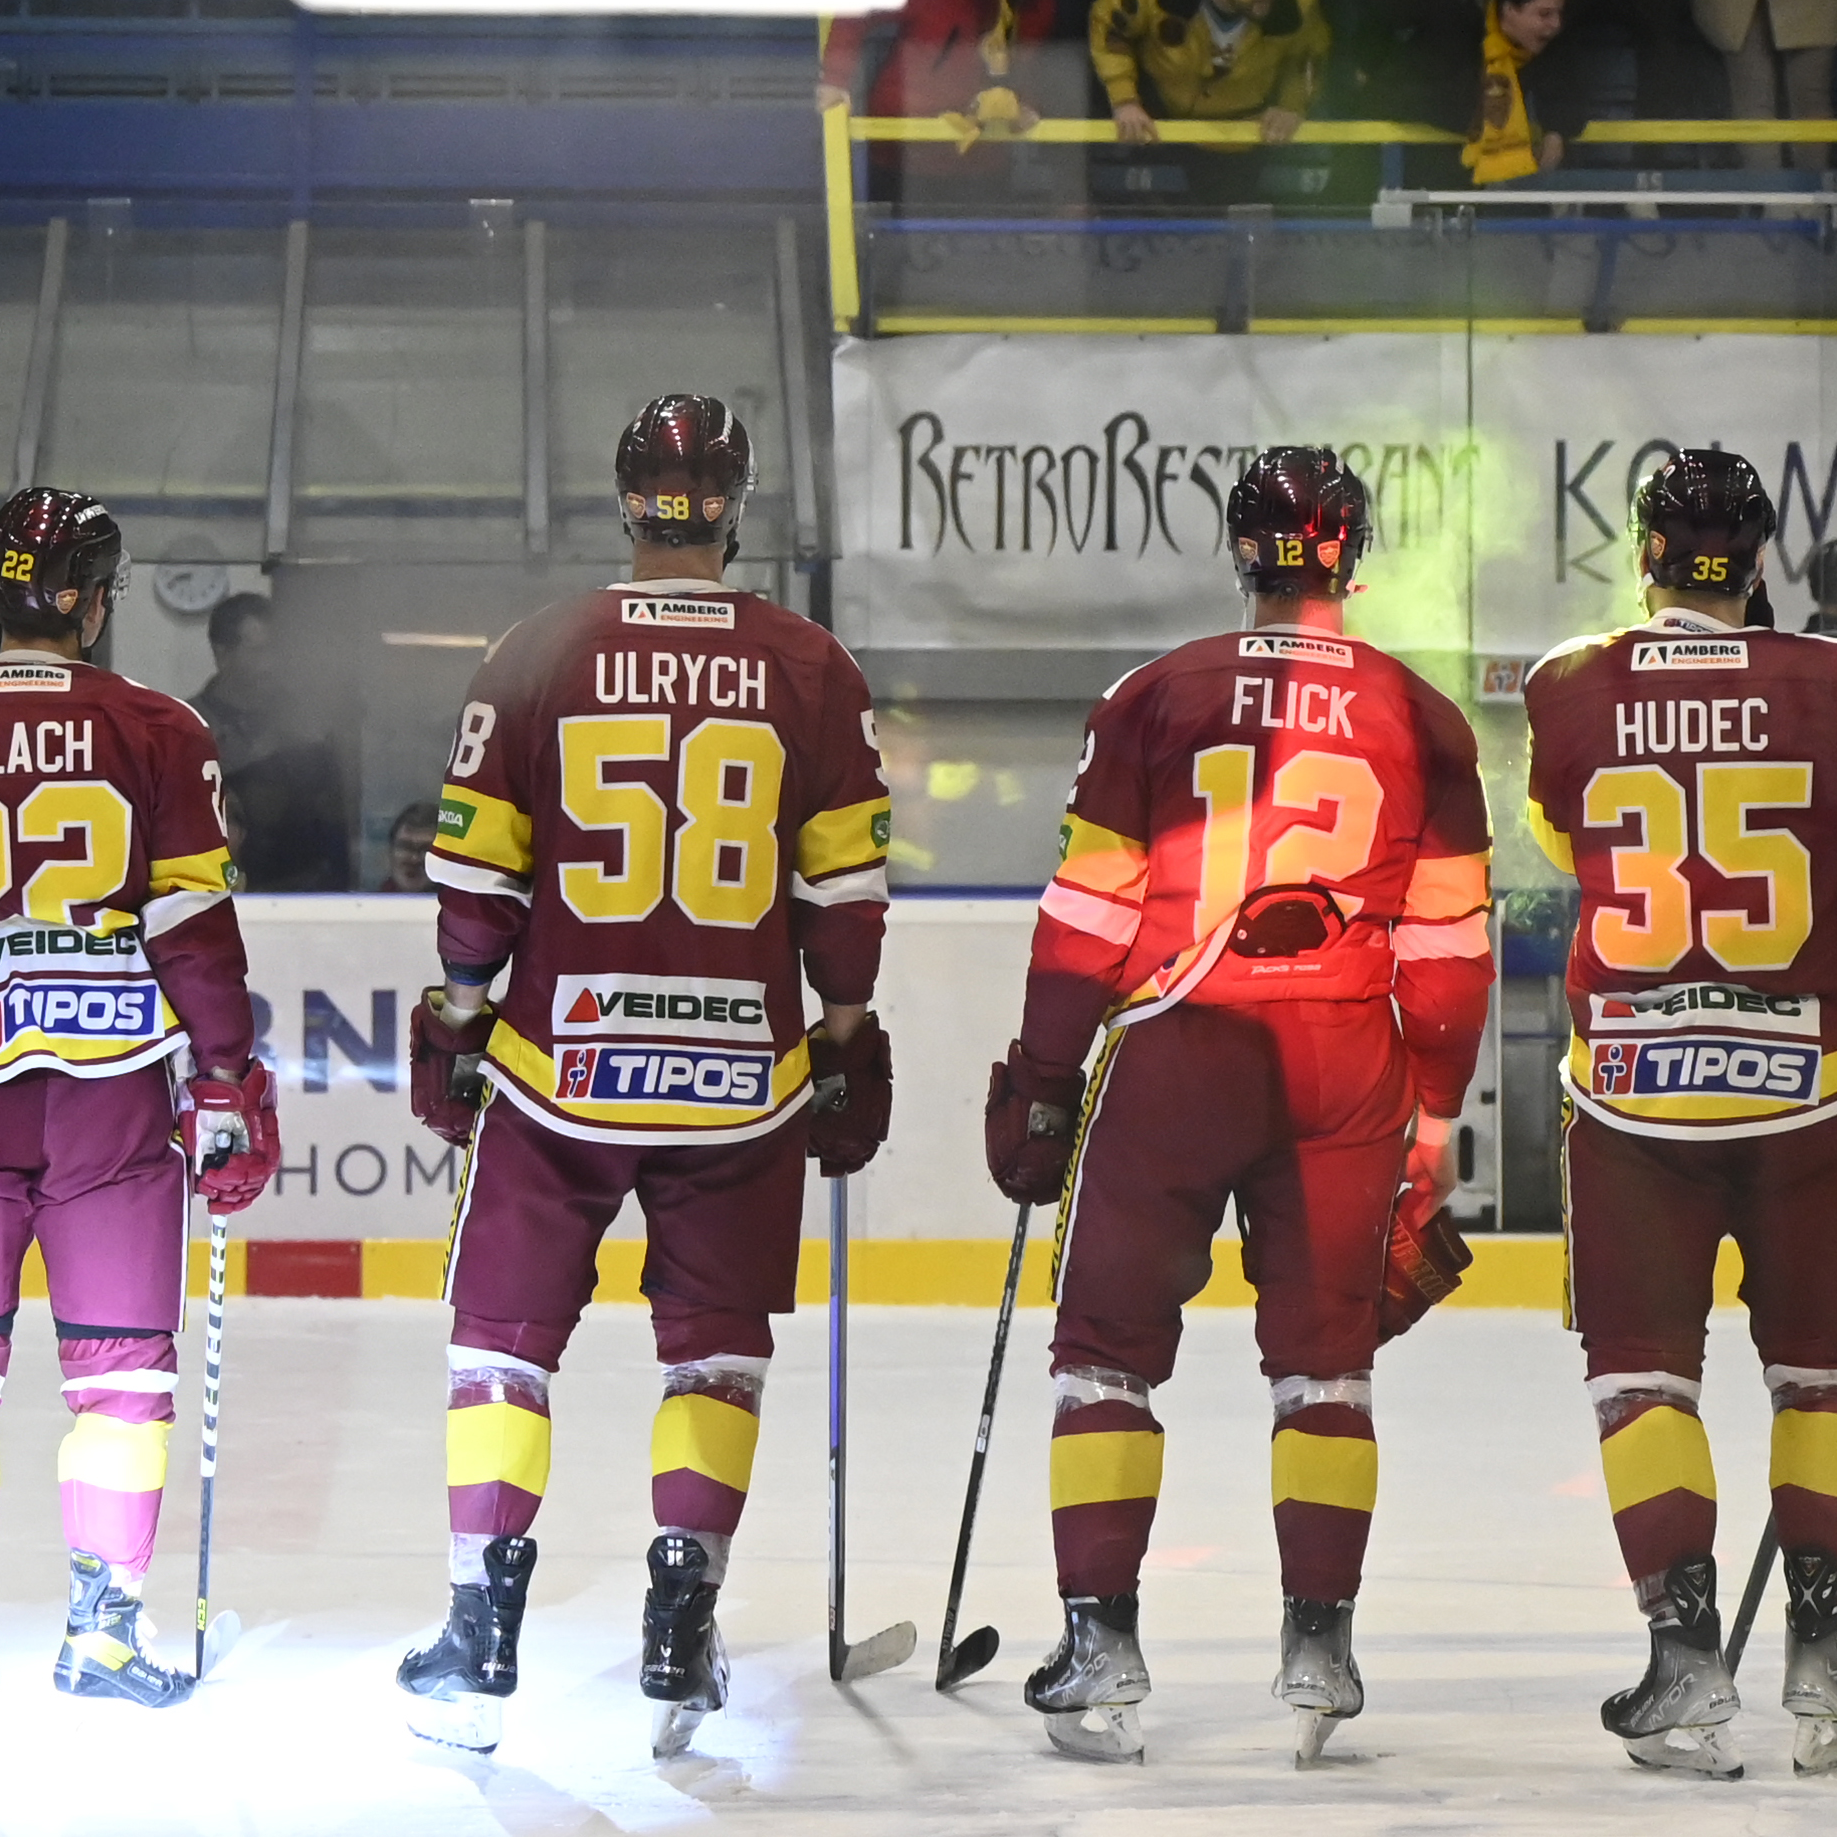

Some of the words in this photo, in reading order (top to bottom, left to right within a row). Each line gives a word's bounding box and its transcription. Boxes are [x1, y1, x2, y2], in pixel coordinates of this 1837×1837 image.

[655, 495, 691, 522] 58
[0, 549, 36, 583] 22
[1275, 539, 1305, 567] 12
[1692, 556, 1729, 583] 35
[659, 602, 729, 616] AMBERG
[1279, 638, 1349, 659] AMBERG
[1671, 644, 1742, 659] AMBERG
[0, 668, 66, 681] AMBERG
[594, 650, 767, 711] ULRYCH
[1230, 675, 1357, 739] FLICK
[1614, 697, 1769, 758] HUDEC
[444, 700, 497, 779] 8
[557, 712, 787, 931] 58
[1192, 743, 1385, 943] 12
[1582, 760, 1814, 974] 35
[8, 986, 146, 1032] TIPOS
[596, 991, 764, 1024] VEIDEC
[608, 1053, 761, 1100] TIPOS
[1646, 1045, 1808, 1091] TIPOS
